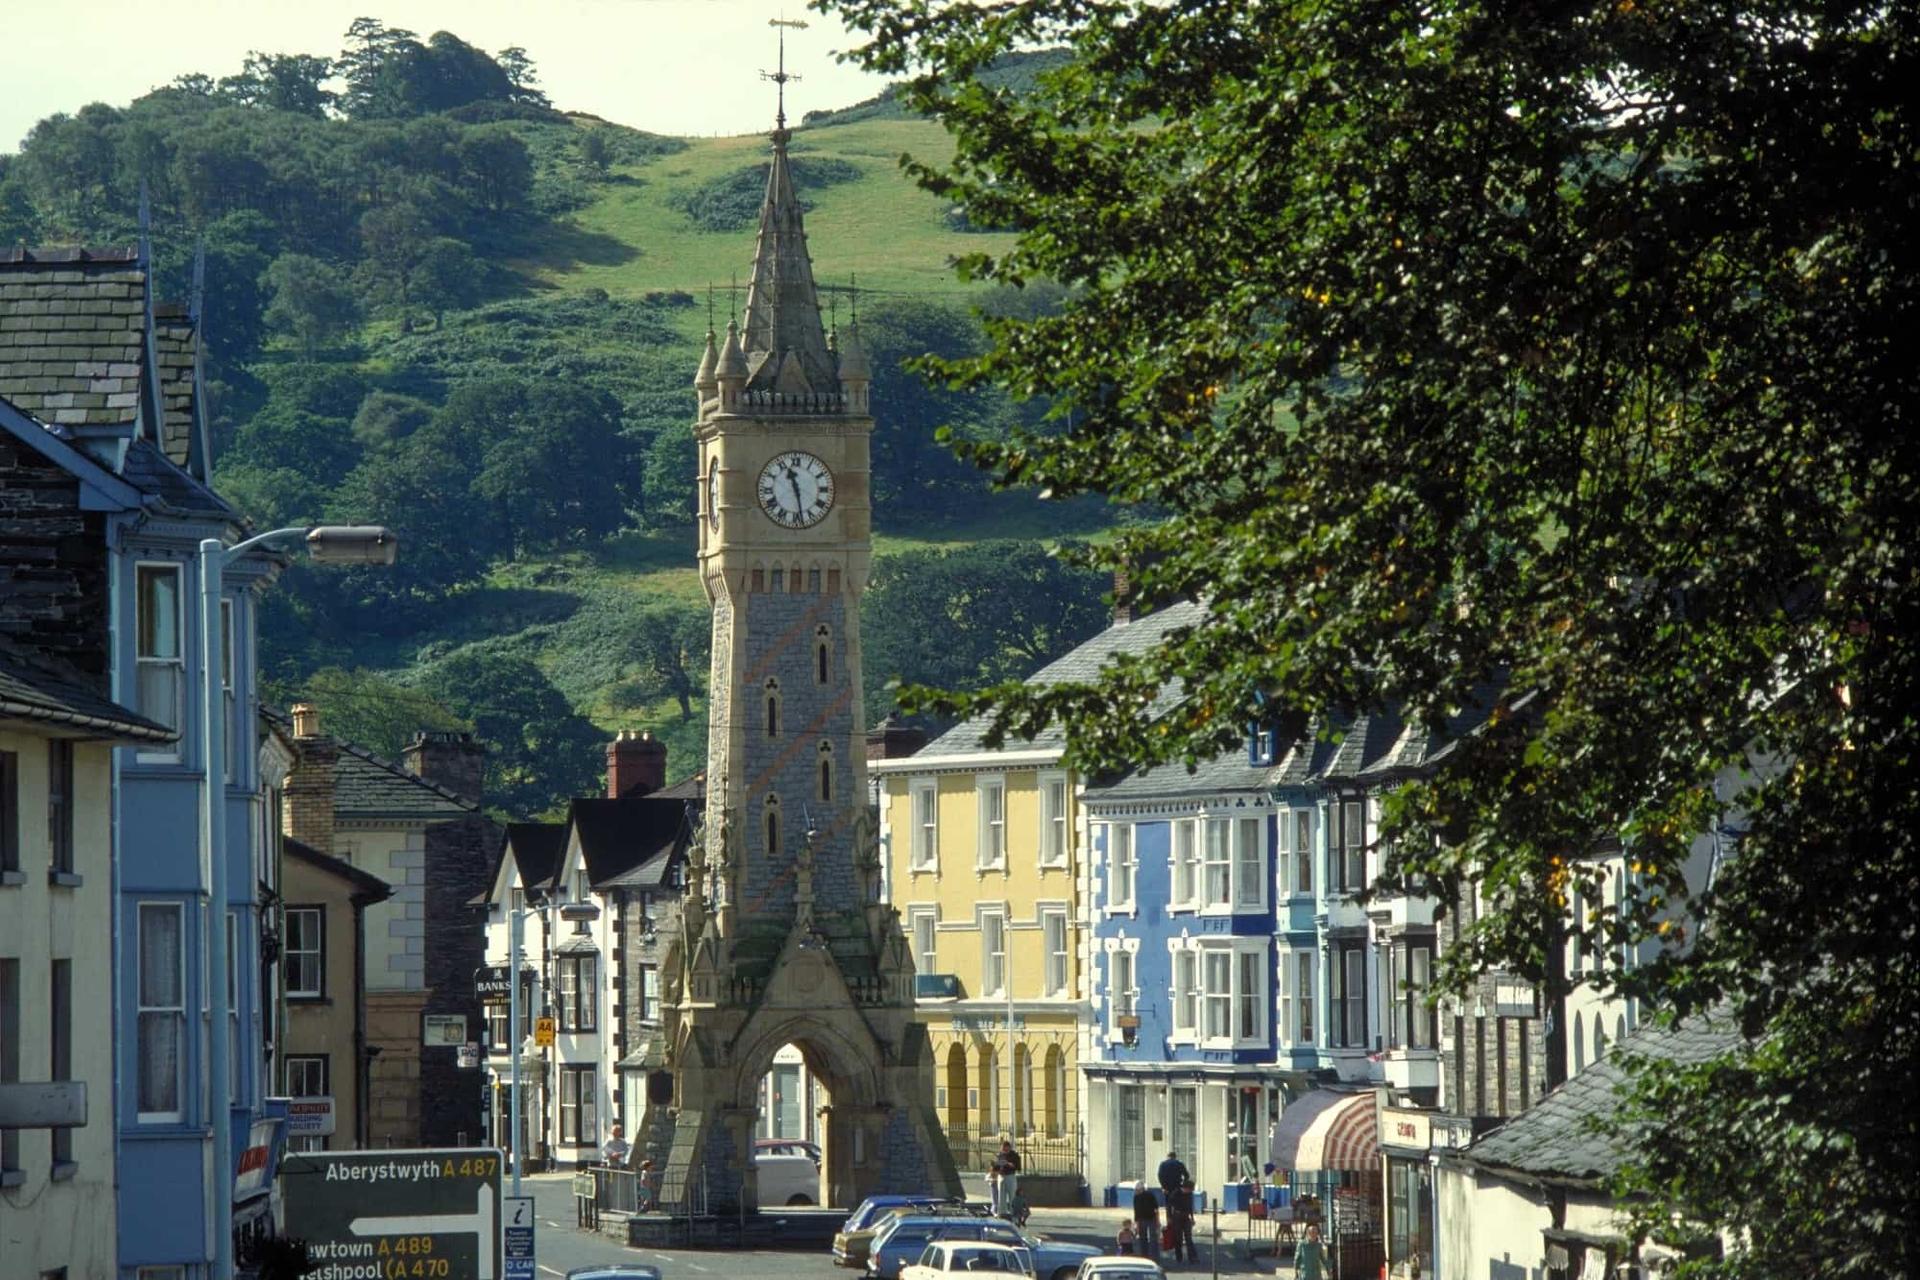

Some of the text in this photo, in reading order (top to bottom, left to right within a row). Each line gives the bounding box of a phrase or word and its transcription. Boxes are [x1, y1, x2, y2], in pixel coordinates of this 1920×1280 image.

[538, 1021, 552, 1032] AA
[325, 1160, 440, 1183] Aberystwyth
[310, 1240, 373, 1259] wtown
[299, 1260, 383, 1280] elshpool
